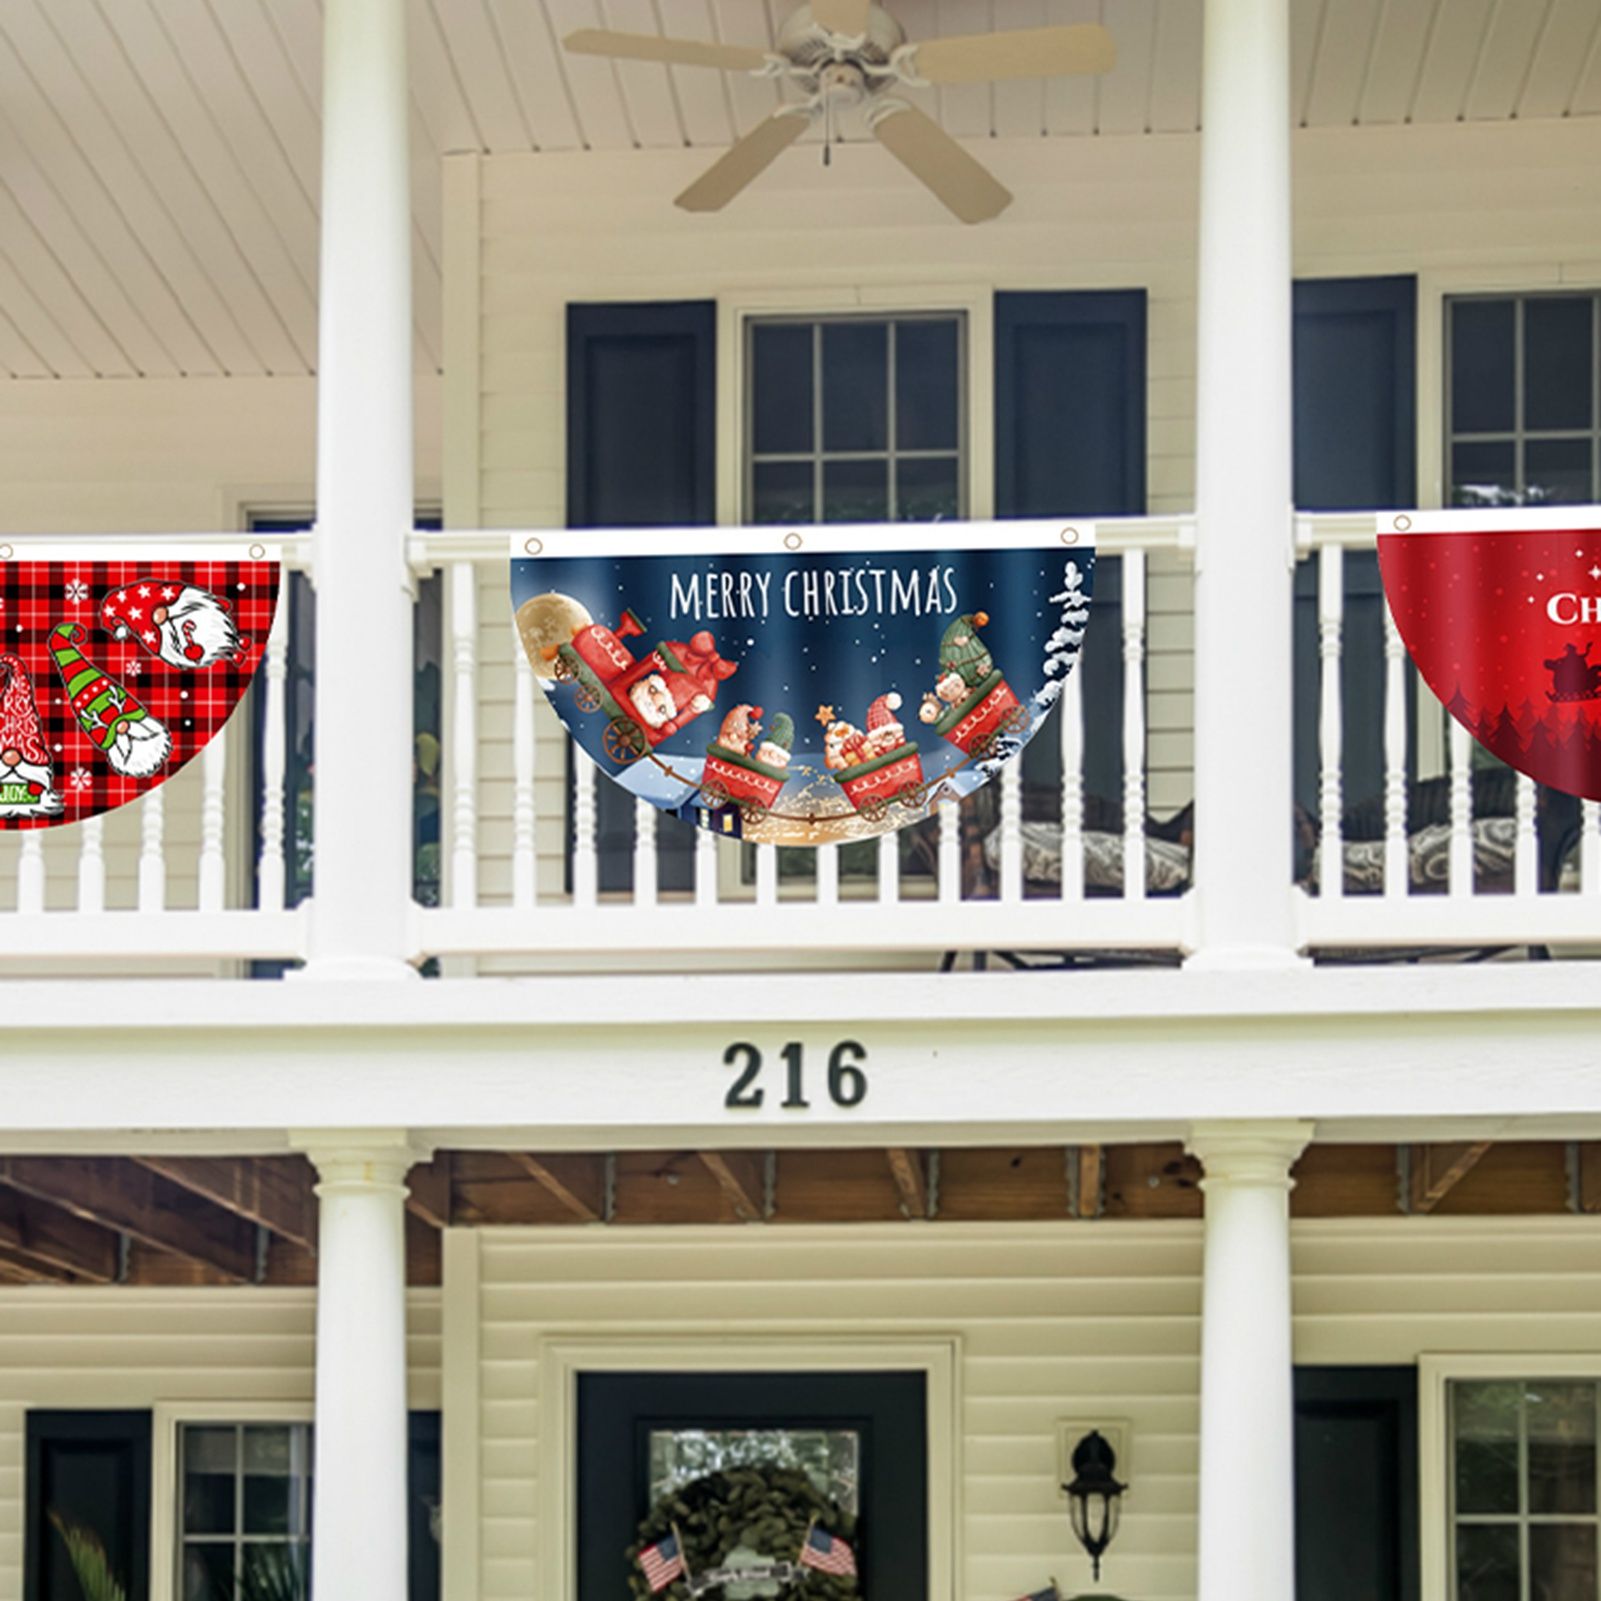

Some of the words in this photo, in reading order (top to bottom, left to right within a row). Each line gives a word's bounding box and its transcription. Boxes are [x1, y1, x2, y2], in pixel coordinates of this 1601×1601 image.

[670, 572, 771, 621] MERRY
[784, 567, 958, 617] CHRISTMAS
[723, 1040, 868, 1108] 216
